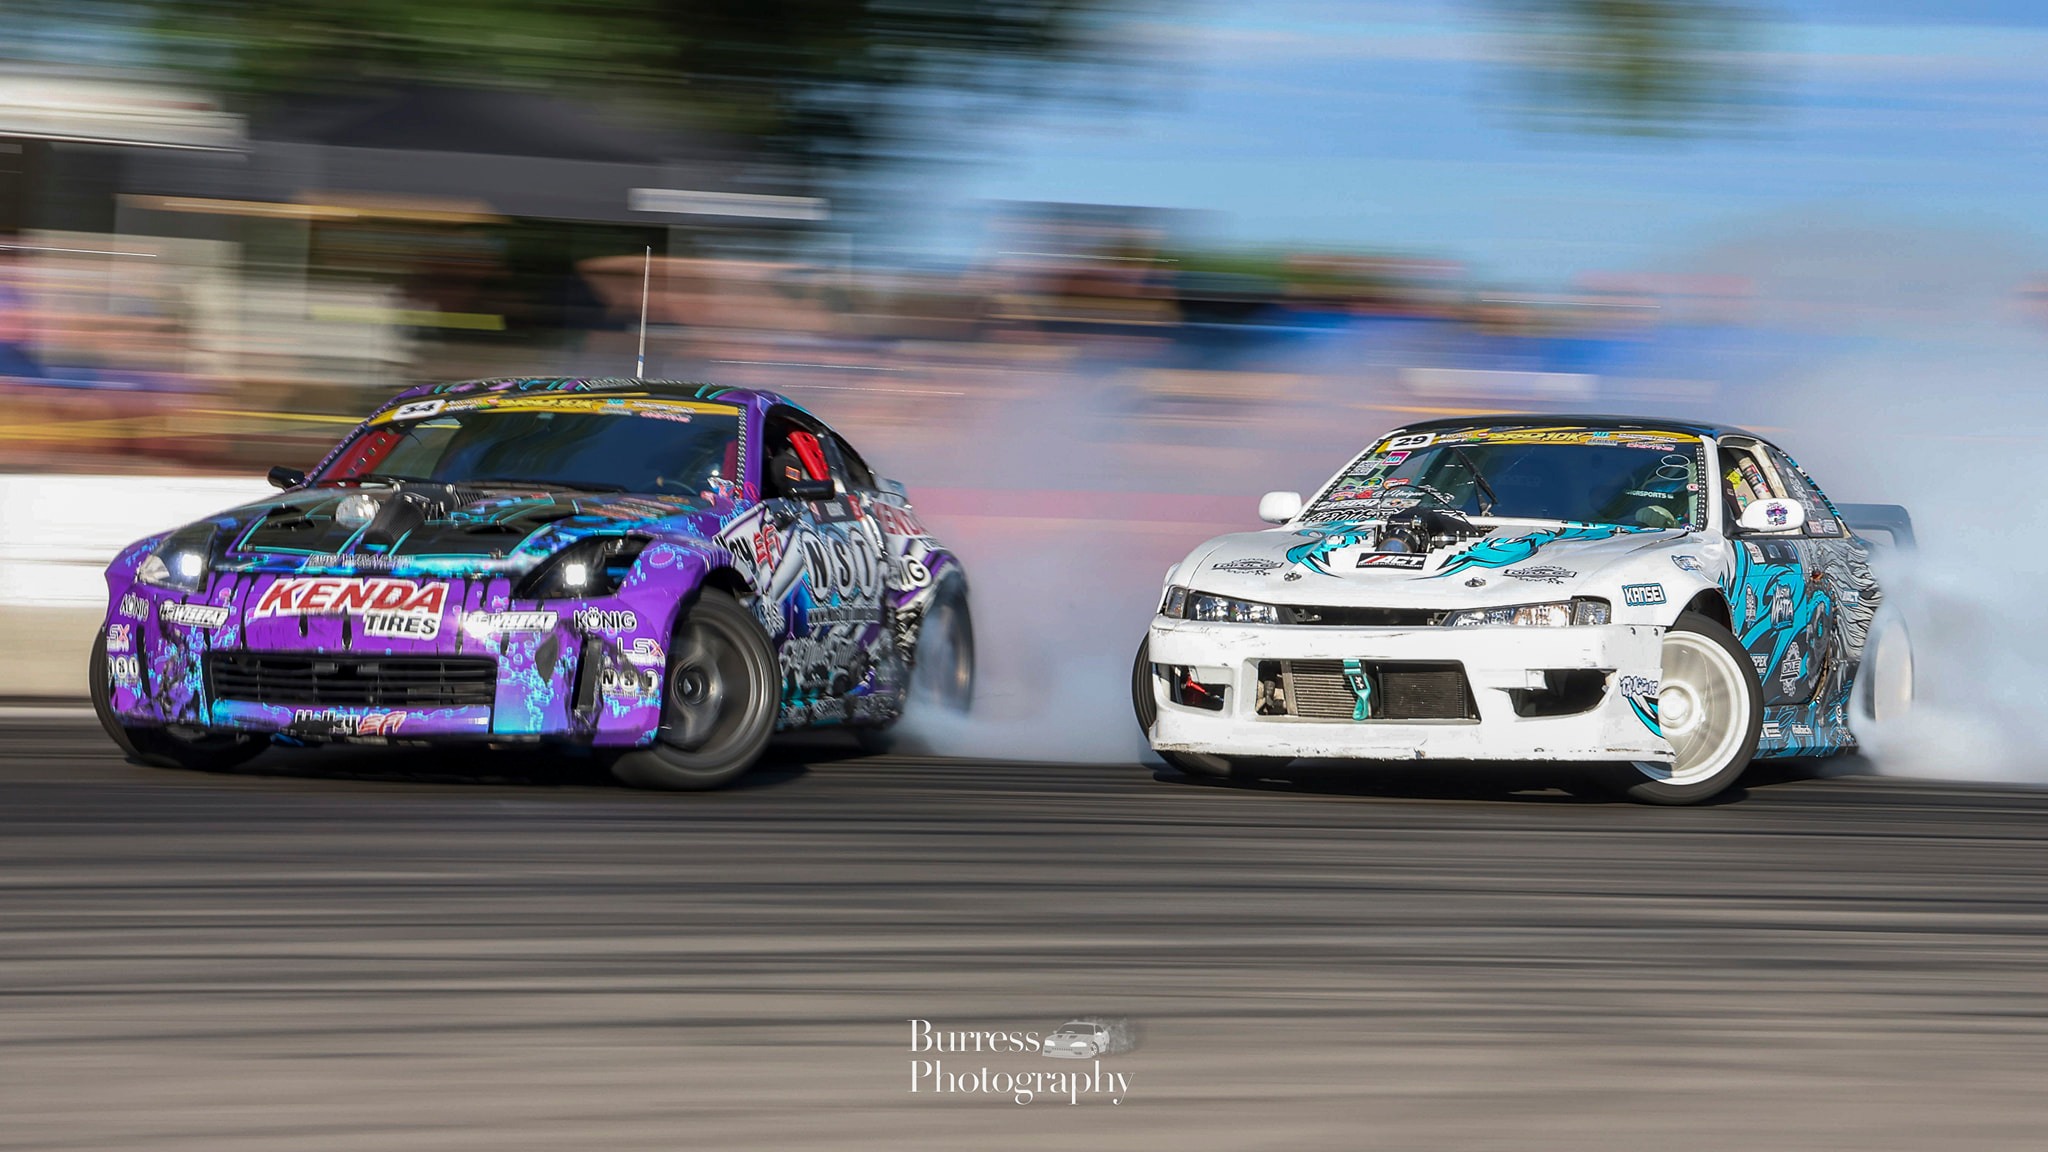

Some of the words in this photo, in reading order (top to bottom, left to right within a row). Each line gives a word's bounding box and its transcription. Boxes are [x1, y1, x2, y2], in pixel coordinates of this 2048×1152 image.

[1394, 436, 1428, 446] 29
[260, 582, 444, 613] KENDA
[366, 615, 437, 635] TIRES
[574, 608, 637, 630] KÖNIG
[617, 638, 666, 658] LSX
